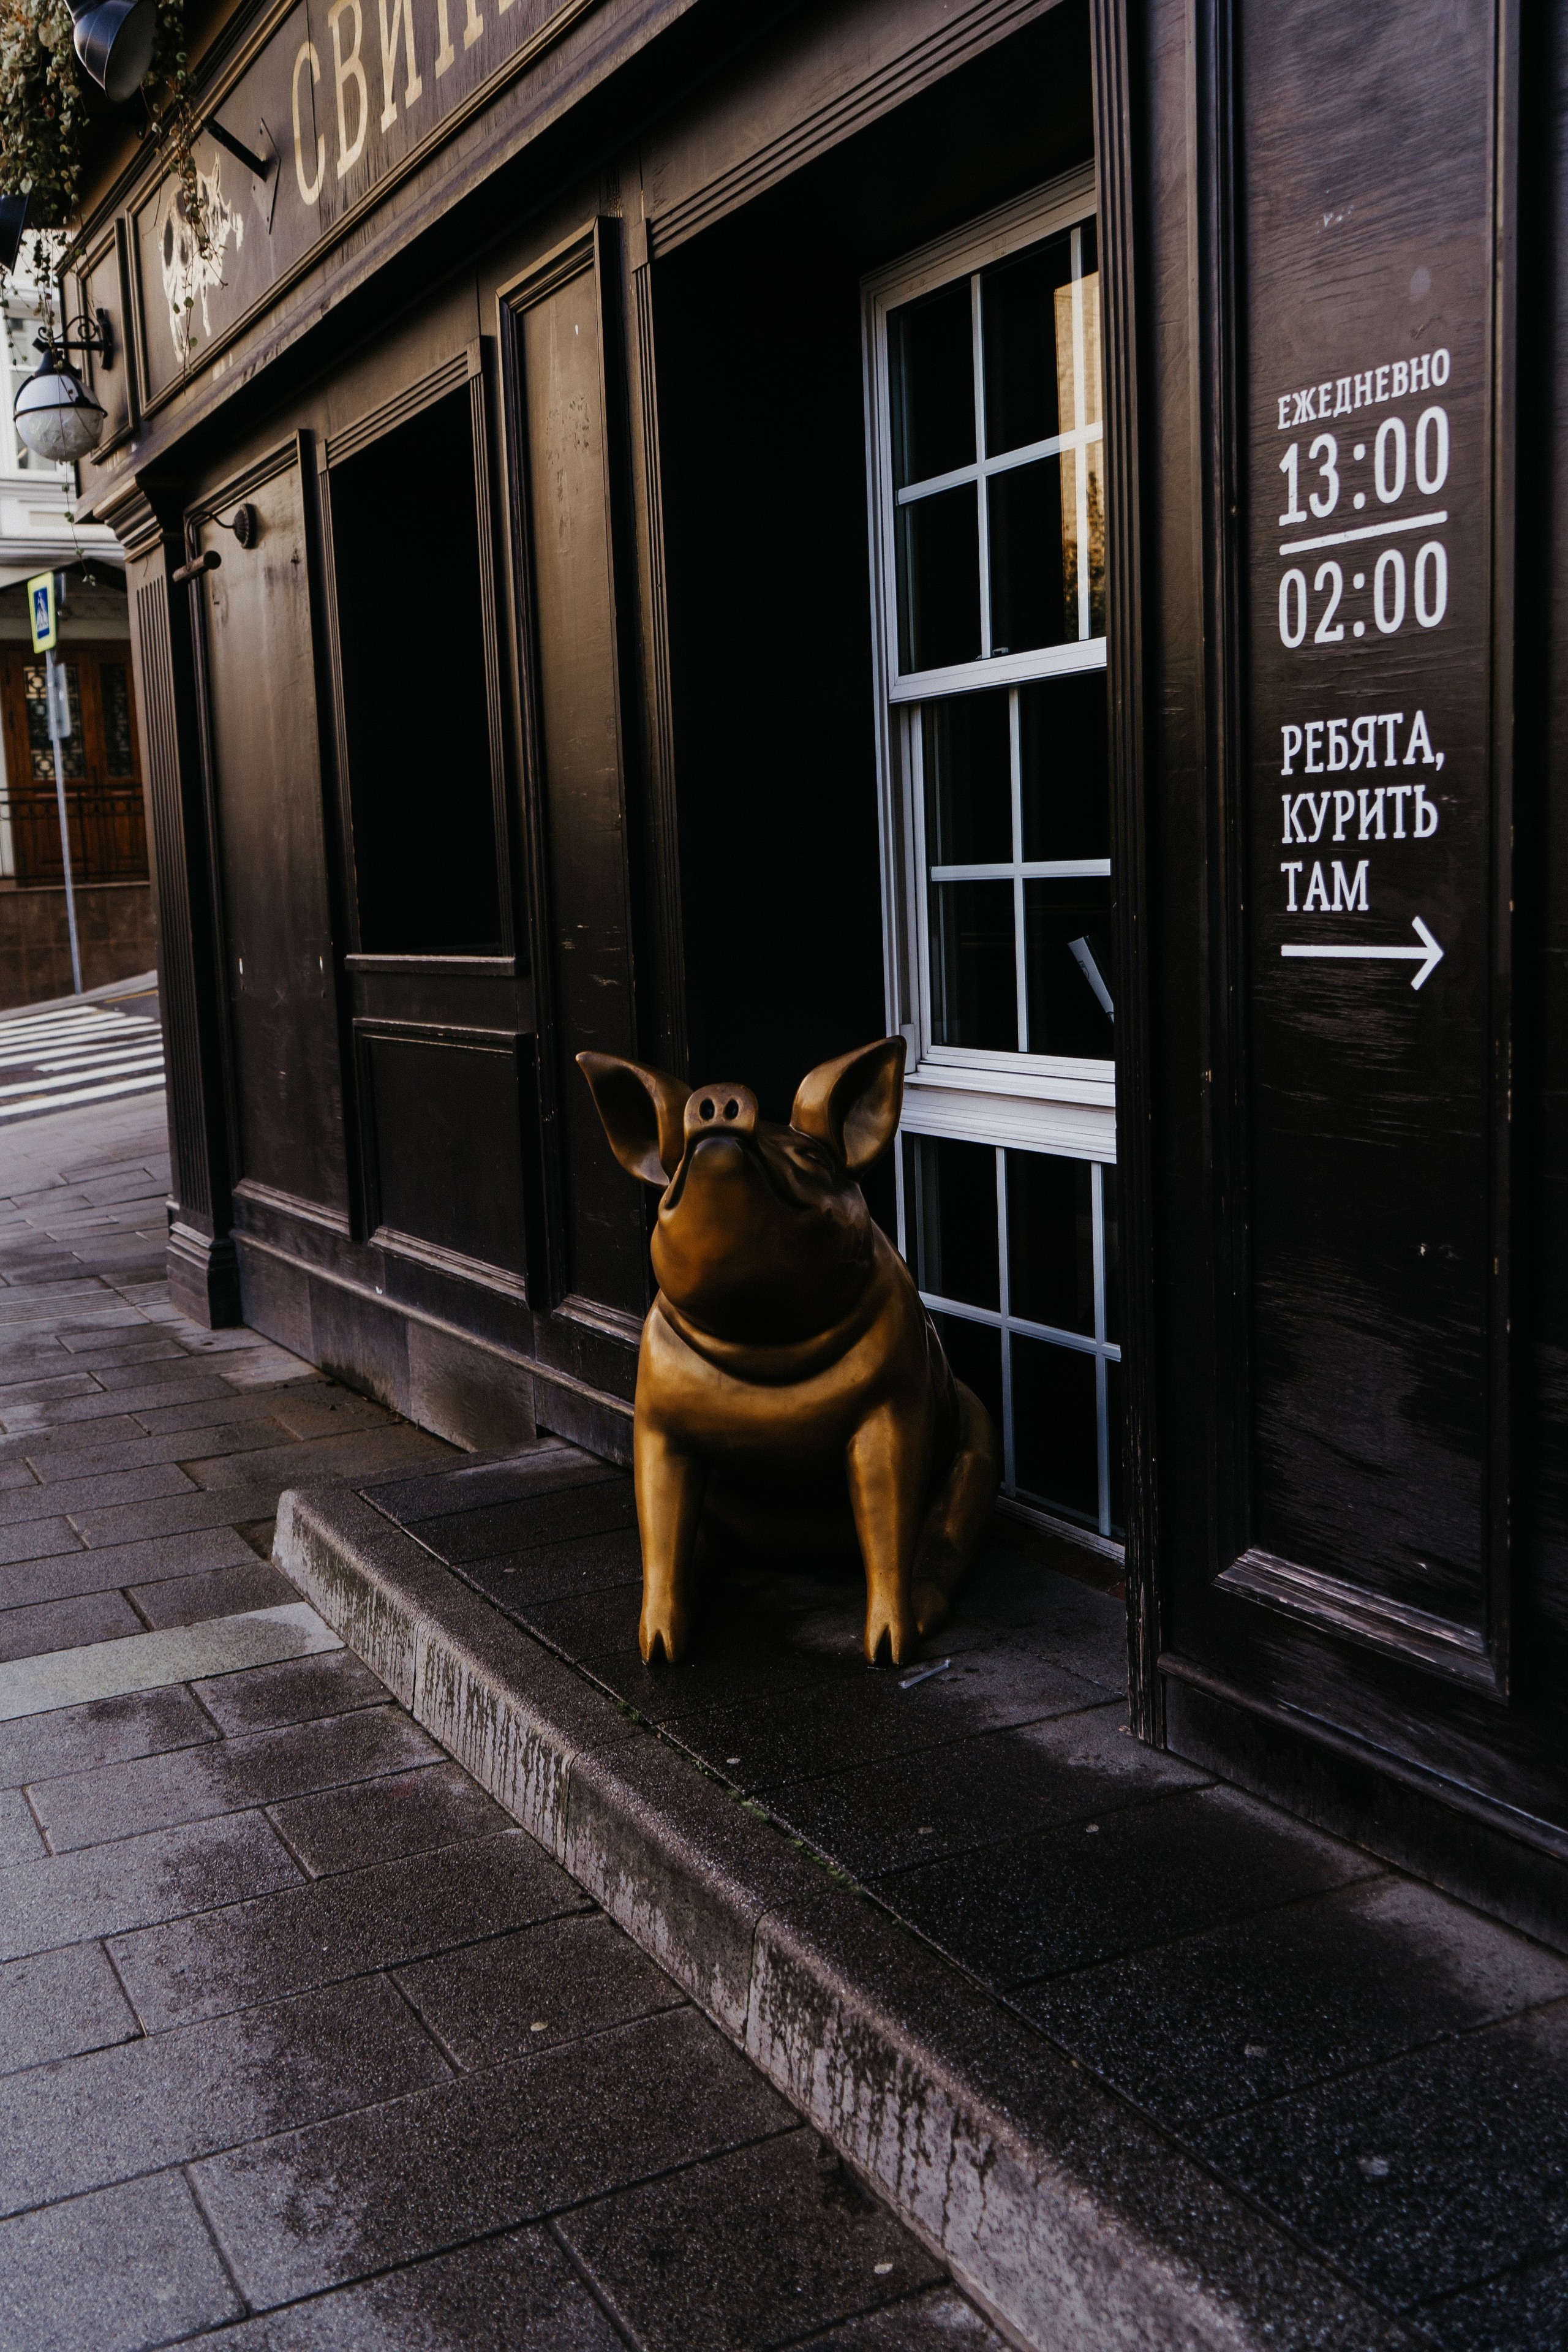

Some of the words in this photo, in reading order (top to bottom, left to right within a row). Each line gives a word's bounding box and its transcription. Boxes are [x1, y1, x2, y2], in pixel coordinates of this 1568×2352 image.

[289, 0, 516, 206] СВИ
[1277, 348, 1450, 430] ЕЖЕДНЕВНО
[1278, 405, 1449, 526] 13:00
[1278, 541, 1448, 648] 02:00
[1280, 710, 1445, 775] РЕБЯТА,
[1281, 785, 1438, 844] КУРИТЬ
[1280, 860, 1370, 912] ТАМ
